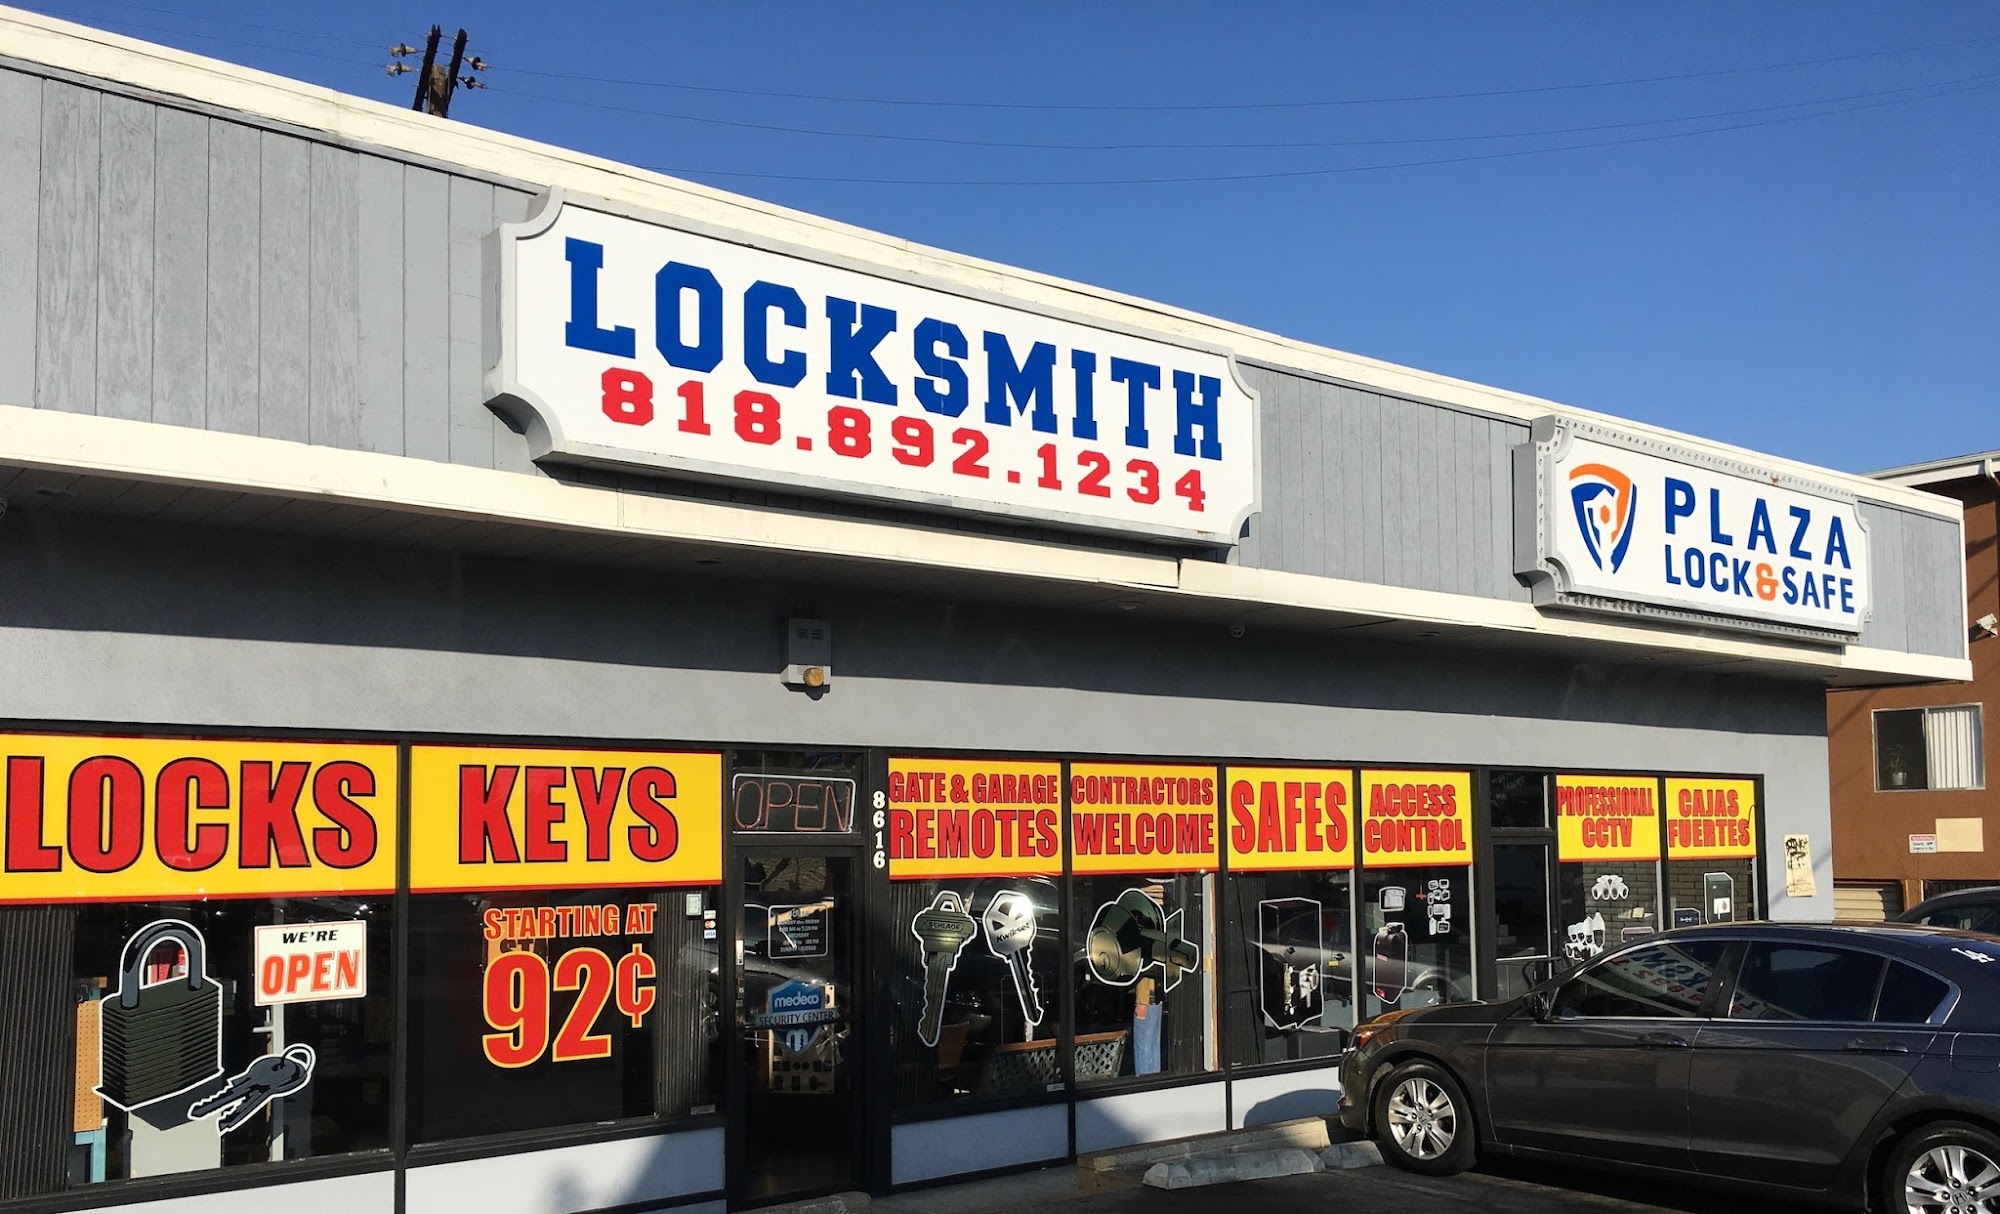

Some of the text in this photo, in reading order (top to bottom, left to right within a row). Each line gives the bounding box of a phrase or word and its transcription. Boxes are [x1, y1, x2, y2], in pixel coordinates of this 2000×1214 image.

[565, 237, 1222, 460] LOCKSMITH
[601, 367, 1206, 512] 818.892.1234
[1664, 476, 1851, 570] PLAZA
[889, 771, 1058, 804] GATE & GARAGE
[1071, 775, 1214, 806] CONTRACTORS
[1369, 783, 1457, 817] ACCESS
[1557, 786, 1655, 817] PROFESSIONAL
[1678, 788, 1740, 817] CAJAS
[4, 755, 377, 874] LOCKS
[458, 764, 679, 864] KEYS
[735, 781, 850, 831] OPEN
[1231, 780, 1348, 854] SAFES
[873, 790, 886, 869] 8616
[889, 809, 1058, 859] REMOTES
[1072, 813, 1214, 855] WELCOME
[1364, 819, 1466, 853] CONTROL
[1582, 818, 1633, 848] CCTV
[1667, 818, 1750, 848] FUERTES
[282, 930, 339, 944] WE'RE
[484, 903, 657, 941] STARTING AT
[928, 921, 961, 931] SCHLAGE
[997, 923, 1030, 942] Kwikset
[261, 949, 361, 996] OPEN
[482, 942, 657, 1069] 92¢
[774, 991, 819, 1007] medeco
[760, 1011, 834, 1026] SECURITY CENTER
